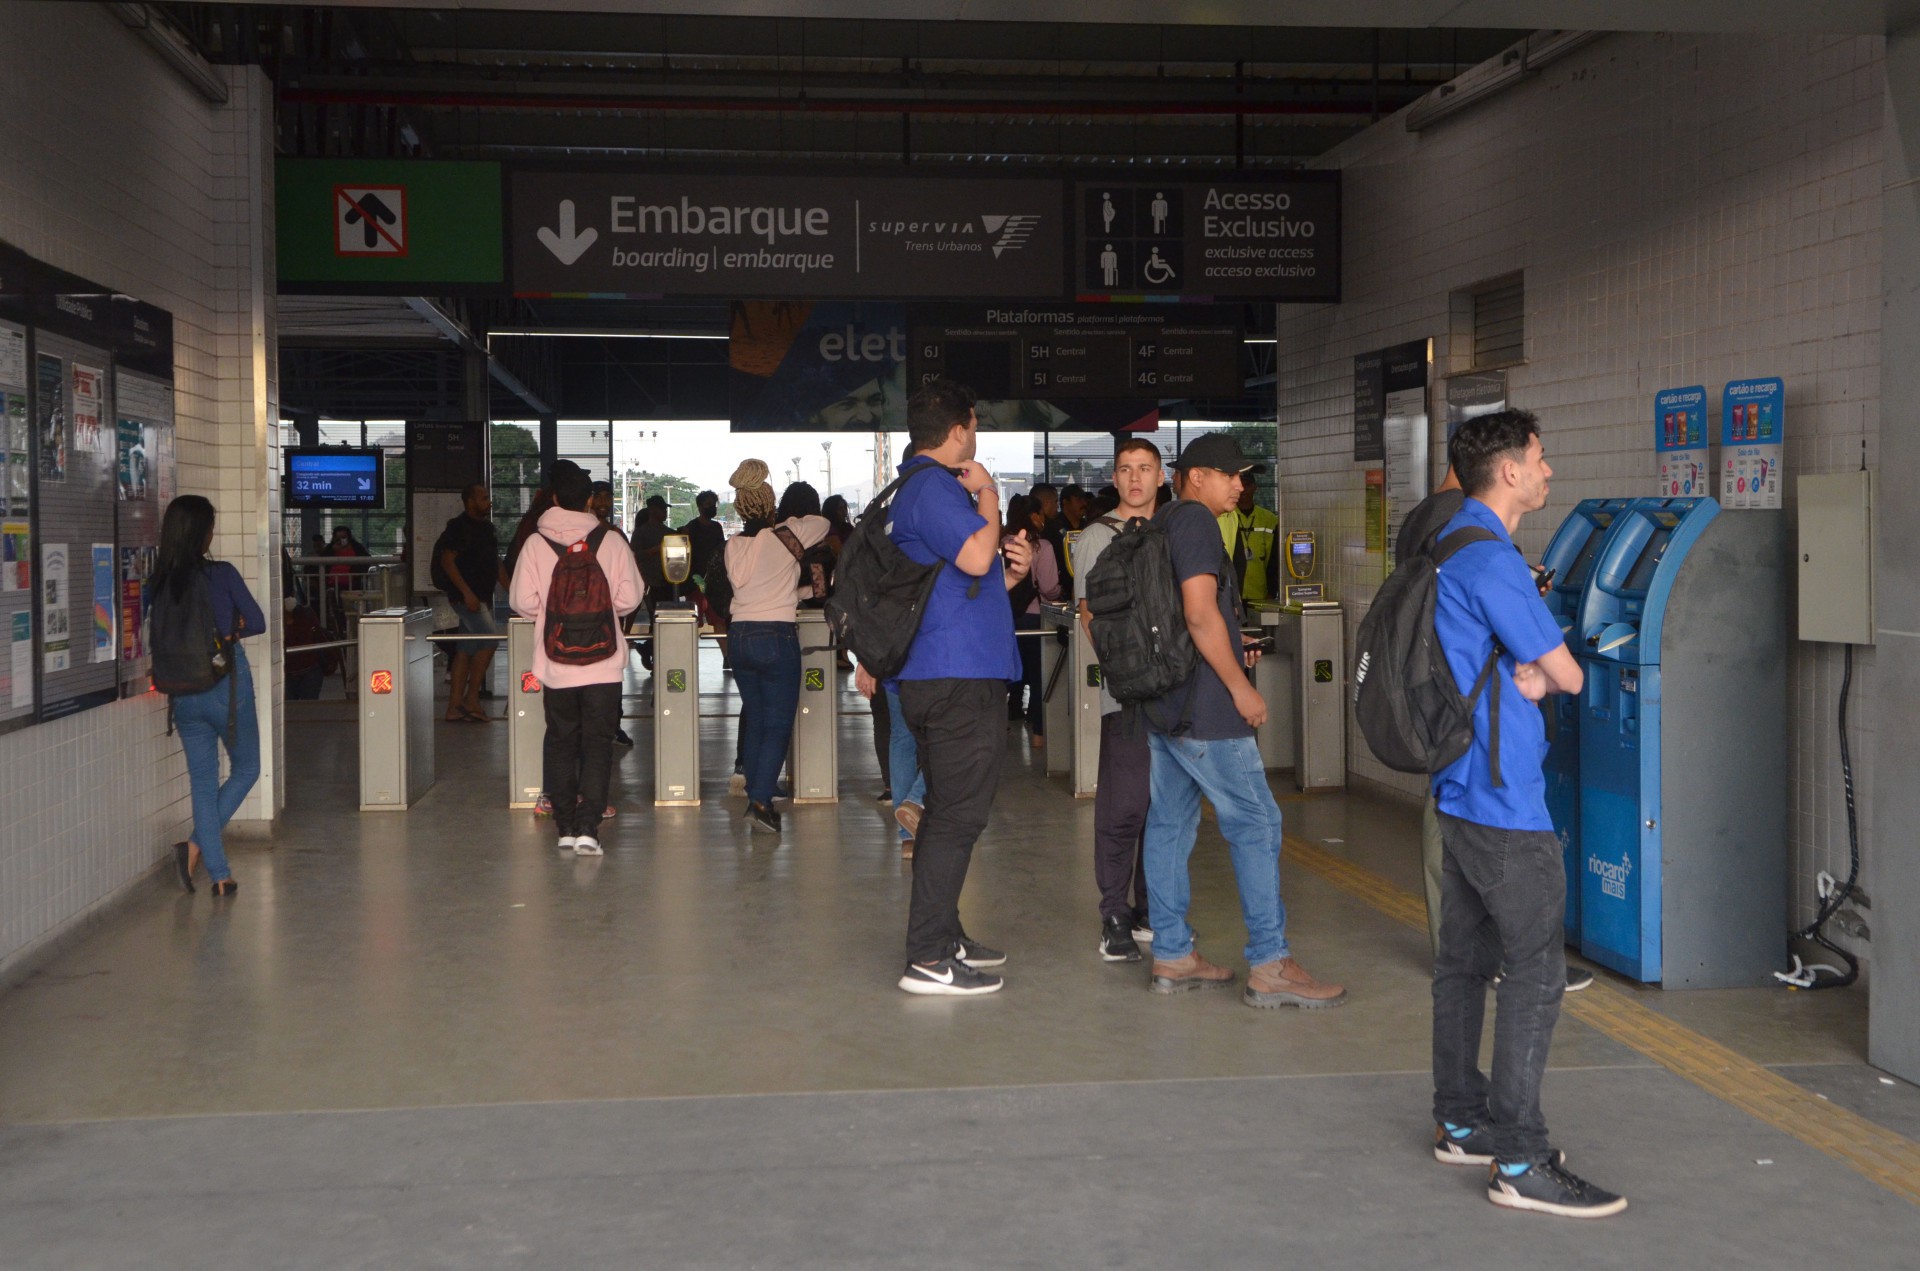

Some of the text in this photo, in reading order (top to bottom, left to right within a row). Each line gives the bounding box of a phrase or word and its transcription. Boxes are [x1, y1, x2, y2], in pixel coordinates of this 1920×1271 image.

[1203, 188, 1291, 210] Acesso
[610, 195, 830, 245] Embarque
[1204, 215, 1315, 238] Exclusivo
[905, 240, 982, 251] Trens Urbanos
[1205, 245, 1315, 258] exclusive access
[612, 246, 835, 273] boarding embarque
[1205, 264, 1316, 277] acceso exclusivo
[986, 309, 1165, 324] Plataformas platforms plataformas
[945, 328, 972, 336] Sentido
[1053, 328, 1080, 336] Sentido
[1161, 328, 1187, 336] Sentido
[819, 323, 906, 362] elet
[923, 345, 939, 358] 6J
[1030, 345, 1086, 359] 5H Central
[1137, 345, 1193, 358] 4F Central
[1055, 373, 1086, 383] Central
[1137, 372, 1194, 385] 4G Central
[1729, 383, 1749, 396] cartão
[1754, 382, 1777, 395] recarga
[1660, 392, 1702, 405] cartão e recarga
[296, 480, 333, 490] 32 min
[1588, 853, 1626, 883] riocard
[1603, 879, 1625, 898] mais
